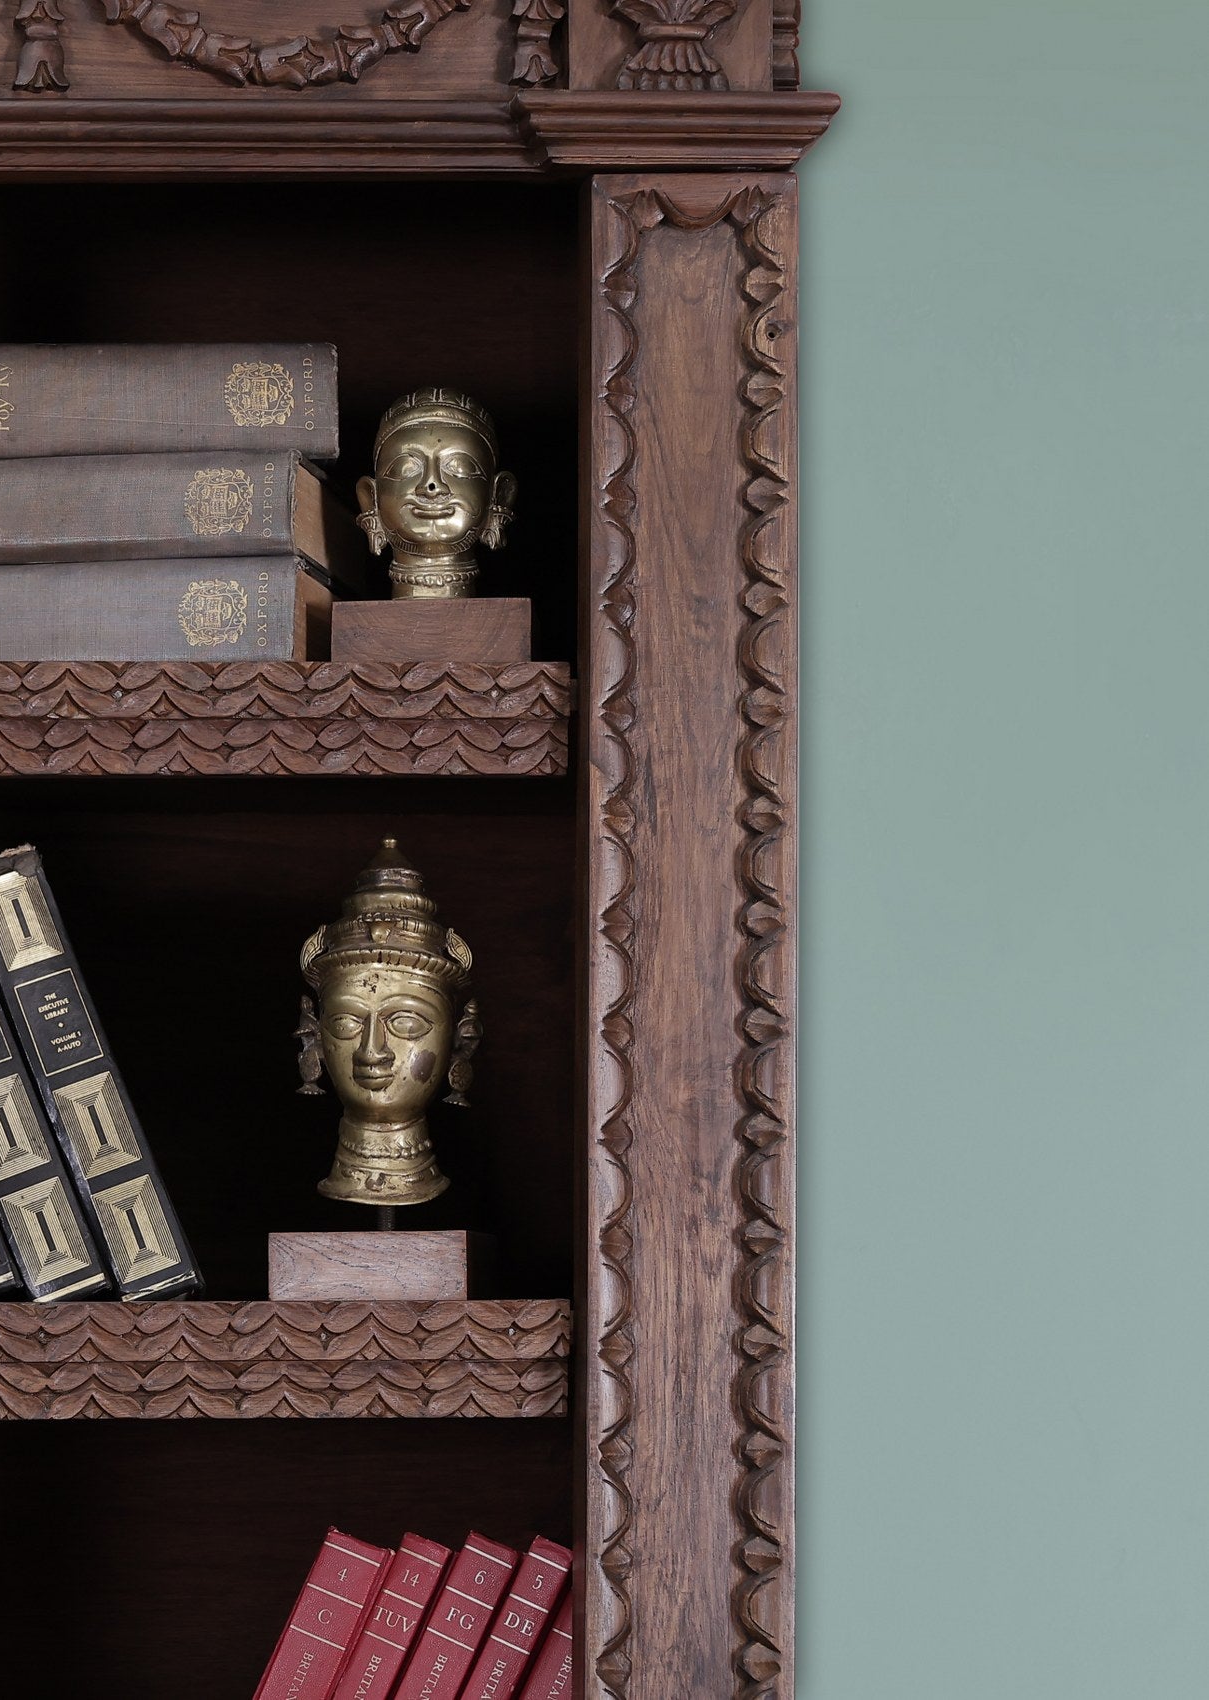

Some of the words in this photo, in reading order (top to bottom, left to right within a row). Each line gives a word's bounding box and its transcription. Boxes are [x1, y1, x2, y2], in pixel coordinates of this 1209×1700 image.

[303, 358, 314, 431] OXFORD
[263, 462, 275, 538] OXFORD
[257, 572, 269, 647] OXFORD
[44, 992, 57, 1001] THE
[38, 998, 69, 1013] EXECUTIVE
[44, 1007, 68, 1020] LIBRARY
[50, 1032, 77, 1045] VOLUME
[57, 1040, 81, 1053] A-AUTO
[337, 1568, 348, 1582] 4
[402, 1569, 420, 1587] 14
[474, 1570, 487, 1584] 6
[532, 1574, 545, 1590] 5
[318, 1609, 333, 1624] C
[373, 1605, 417, 1633] TUV
[445, 1606, 475, 1630] FG
[504, 1611, 535, 1637] DE
[547, 1655, 572, 1700] BRITA
